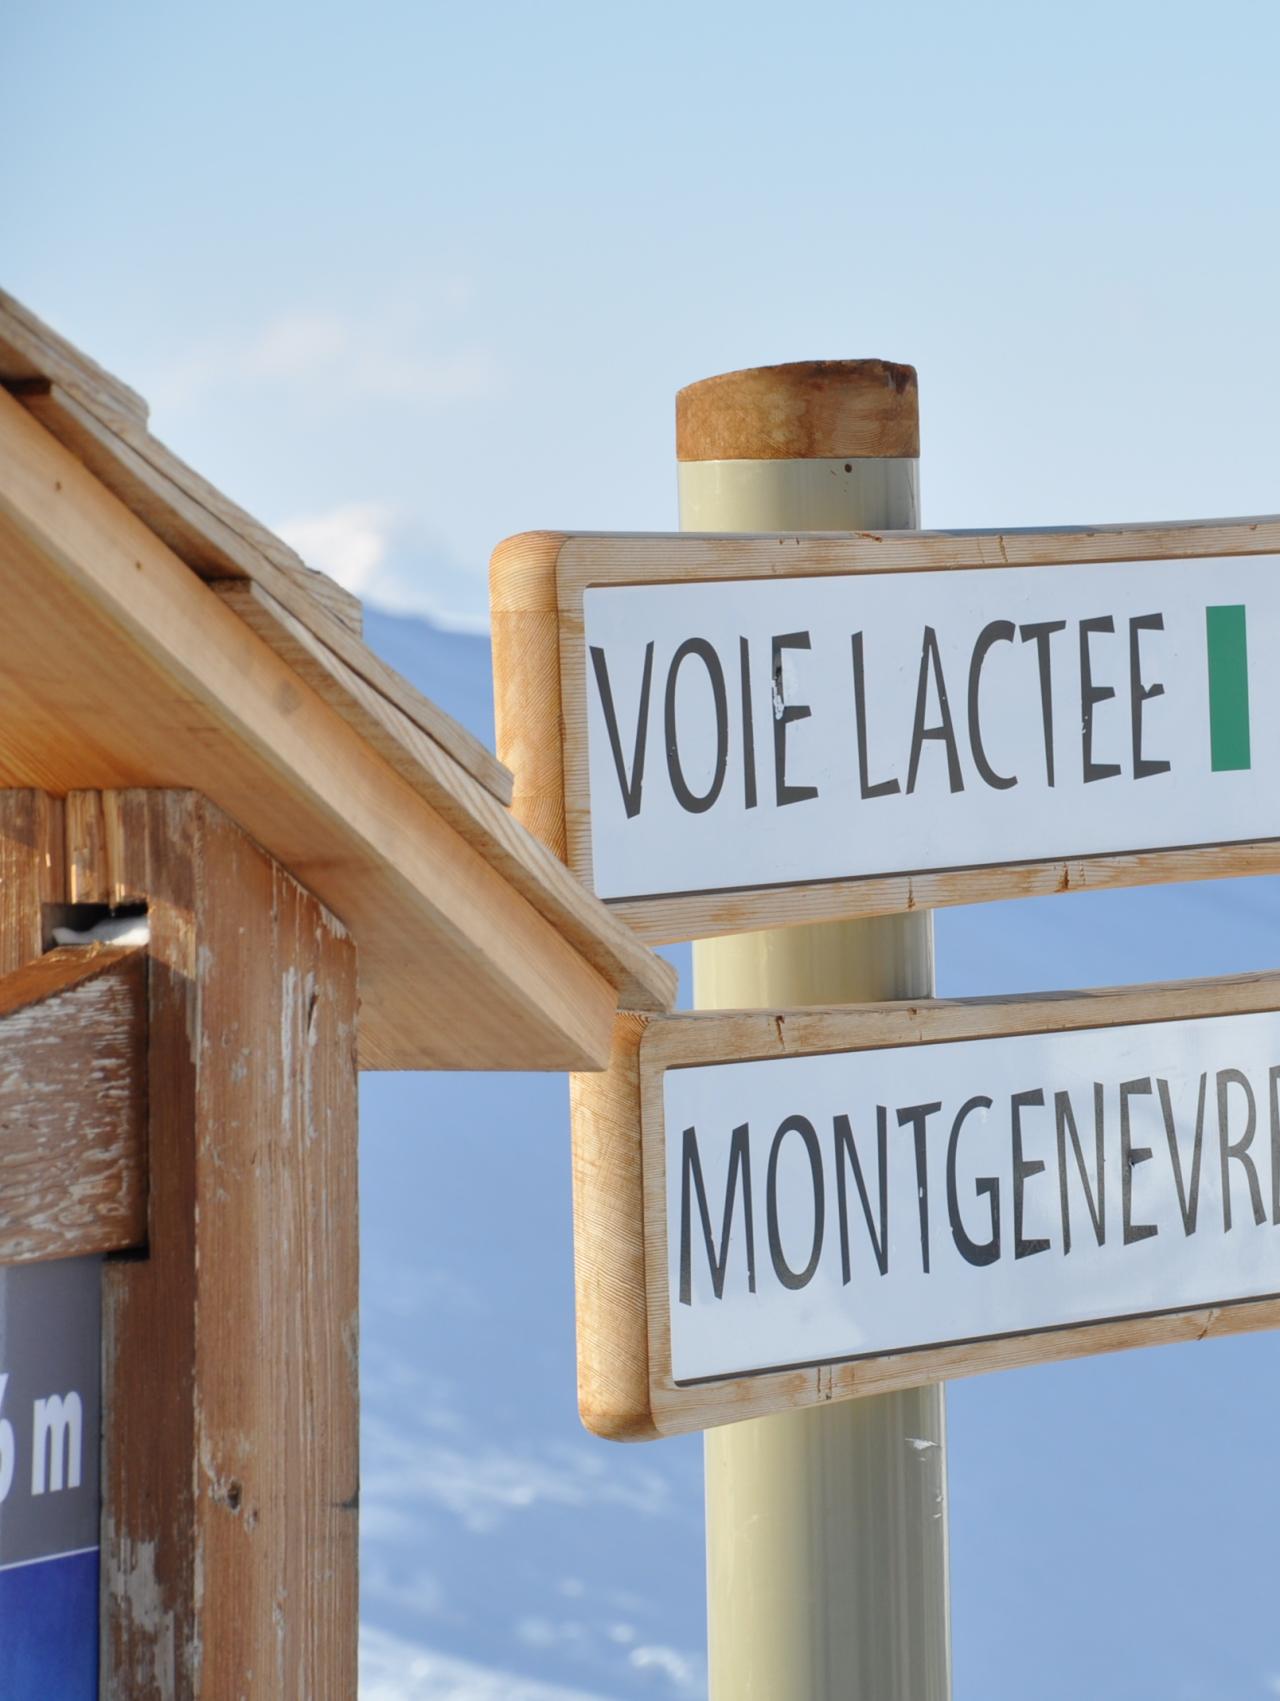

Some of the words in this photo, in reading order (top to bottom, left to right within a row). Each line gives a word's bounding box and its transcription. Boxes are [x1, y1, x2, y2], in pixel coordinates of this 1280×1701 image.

[588, 630, 819, 819] VOIE
[851, 612, 1171, 799] LACTEE
[31, 1391, 83, 1495] m
